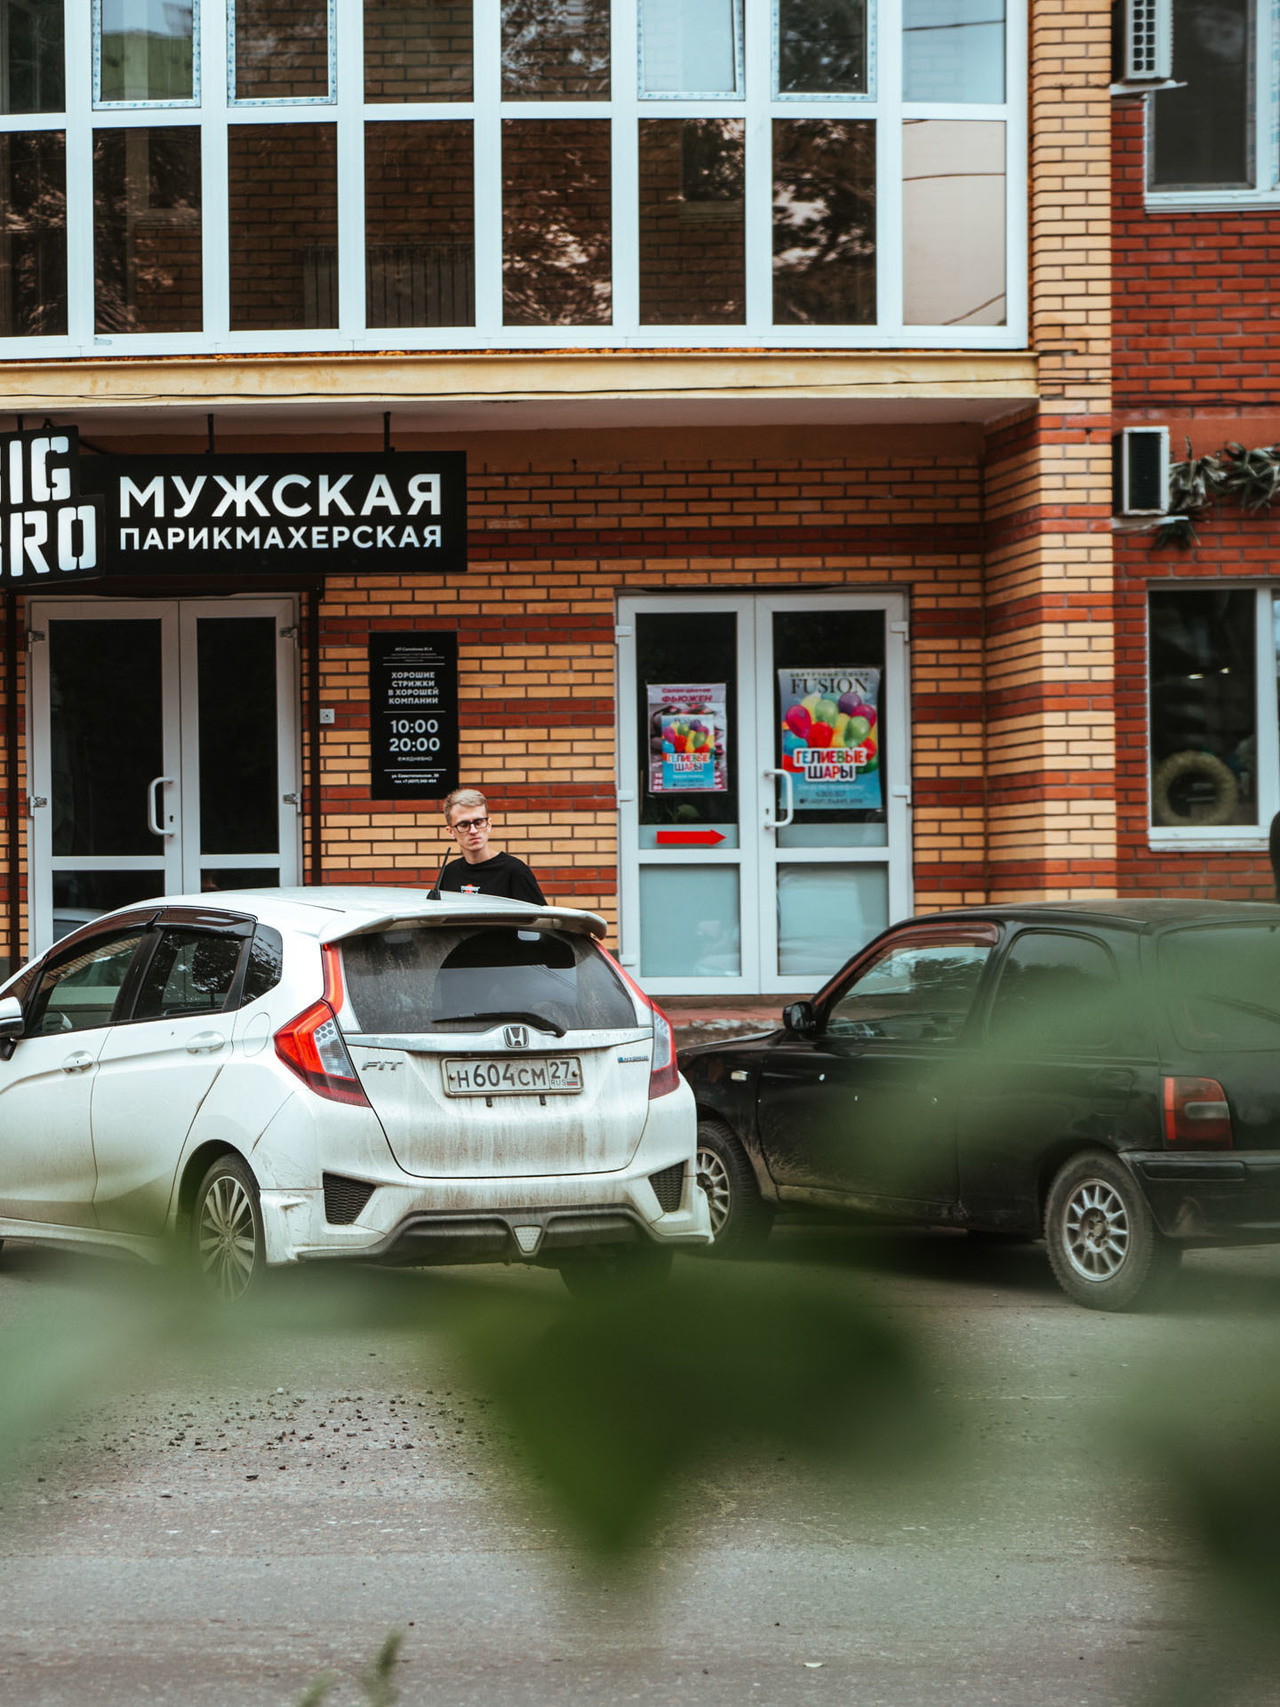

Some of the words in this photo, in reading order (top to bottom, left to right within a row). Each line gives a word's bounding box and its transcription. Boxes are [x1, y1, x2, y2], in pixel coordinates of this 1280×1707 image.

[120, 473, 441, 518] МУЖСКАЯ
[120, 525, 442, 551] ПАРИКМАХЕРСКАЯ
[392, 680, 435, 688] СТРИЖКИ
[396, 687, 439, 696] ХОРОШЕЙ
[791, 678, 868, 694] FUSION
[389, 697, 439, 705] КОМПАНИИ
[390, 719, 439, 734] 10:00
[389, 737, 440, 752] 20:00
[796, 750, 865, 765] ГЕЛИЕВЫЕ
[808, 765, 853, 779] ШАРЫ
[361, 1061, 404, 1071] FIT
